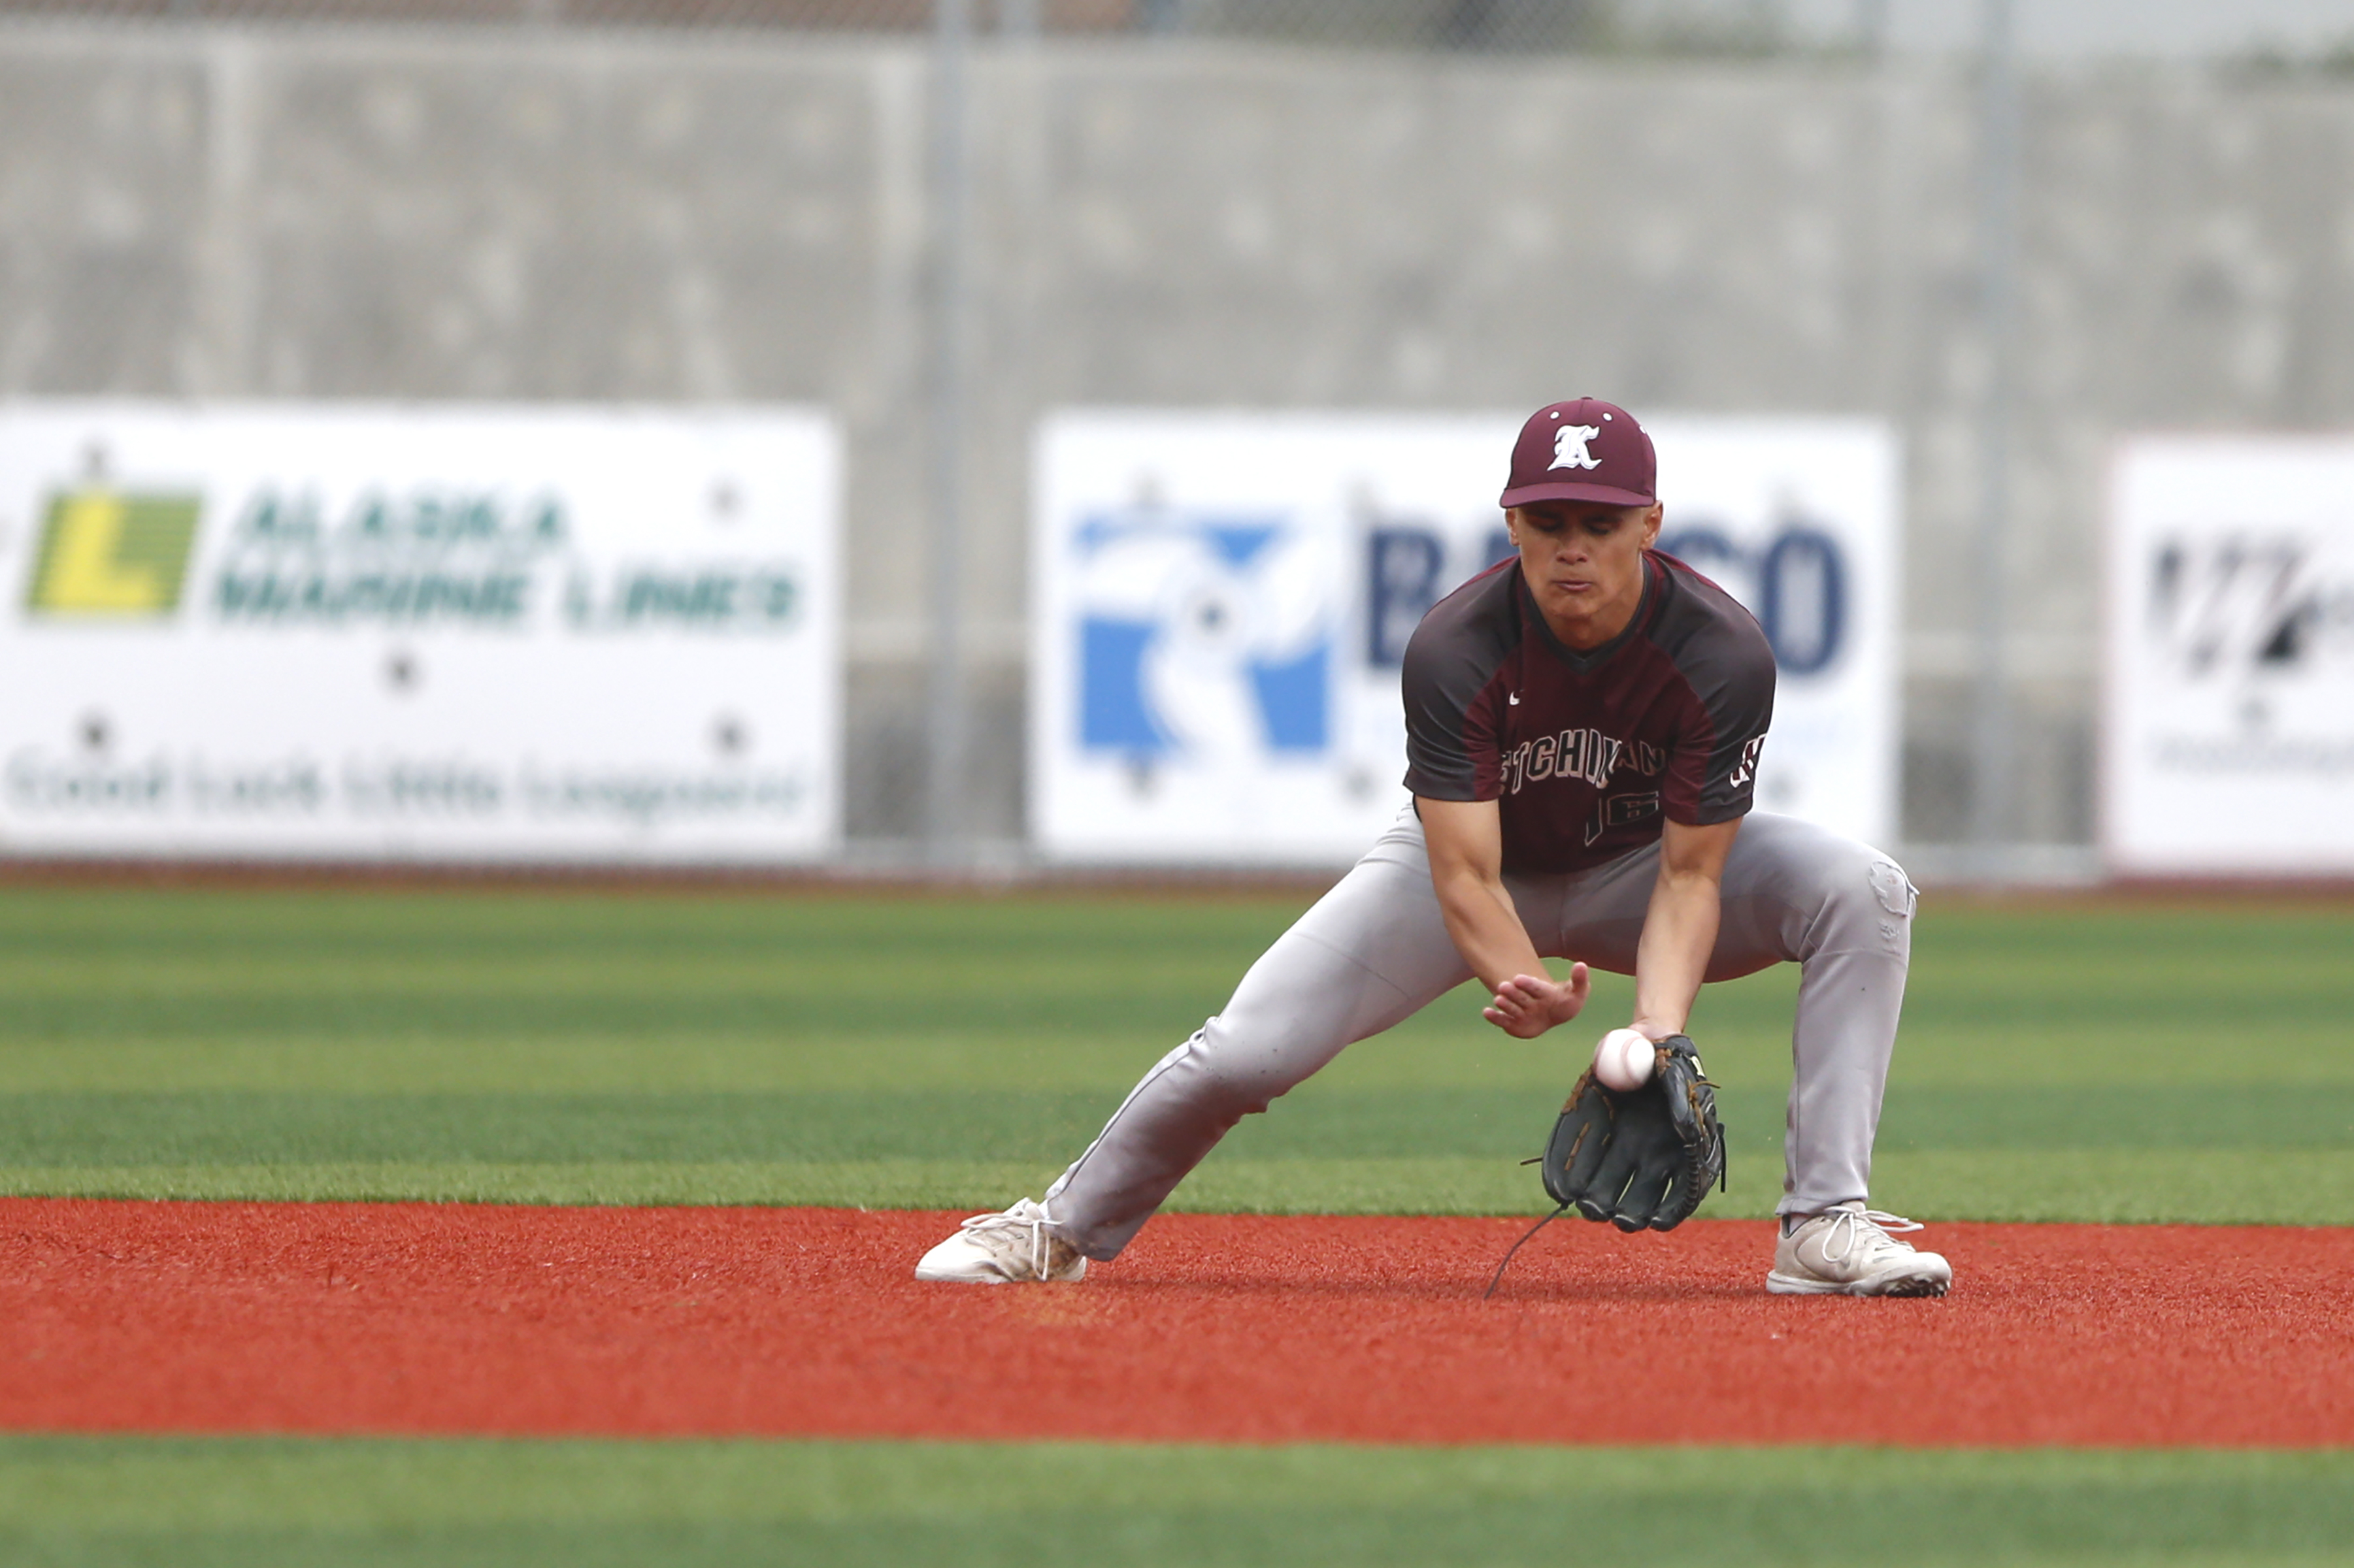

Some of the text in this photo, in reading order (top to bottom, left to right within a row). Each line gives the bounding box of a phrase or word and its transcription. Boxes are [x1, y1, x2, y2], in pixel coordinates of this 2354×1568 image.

[230, 486, 570, 546] ALASKA
[210, 563, 805, 626] MARINE LINES
